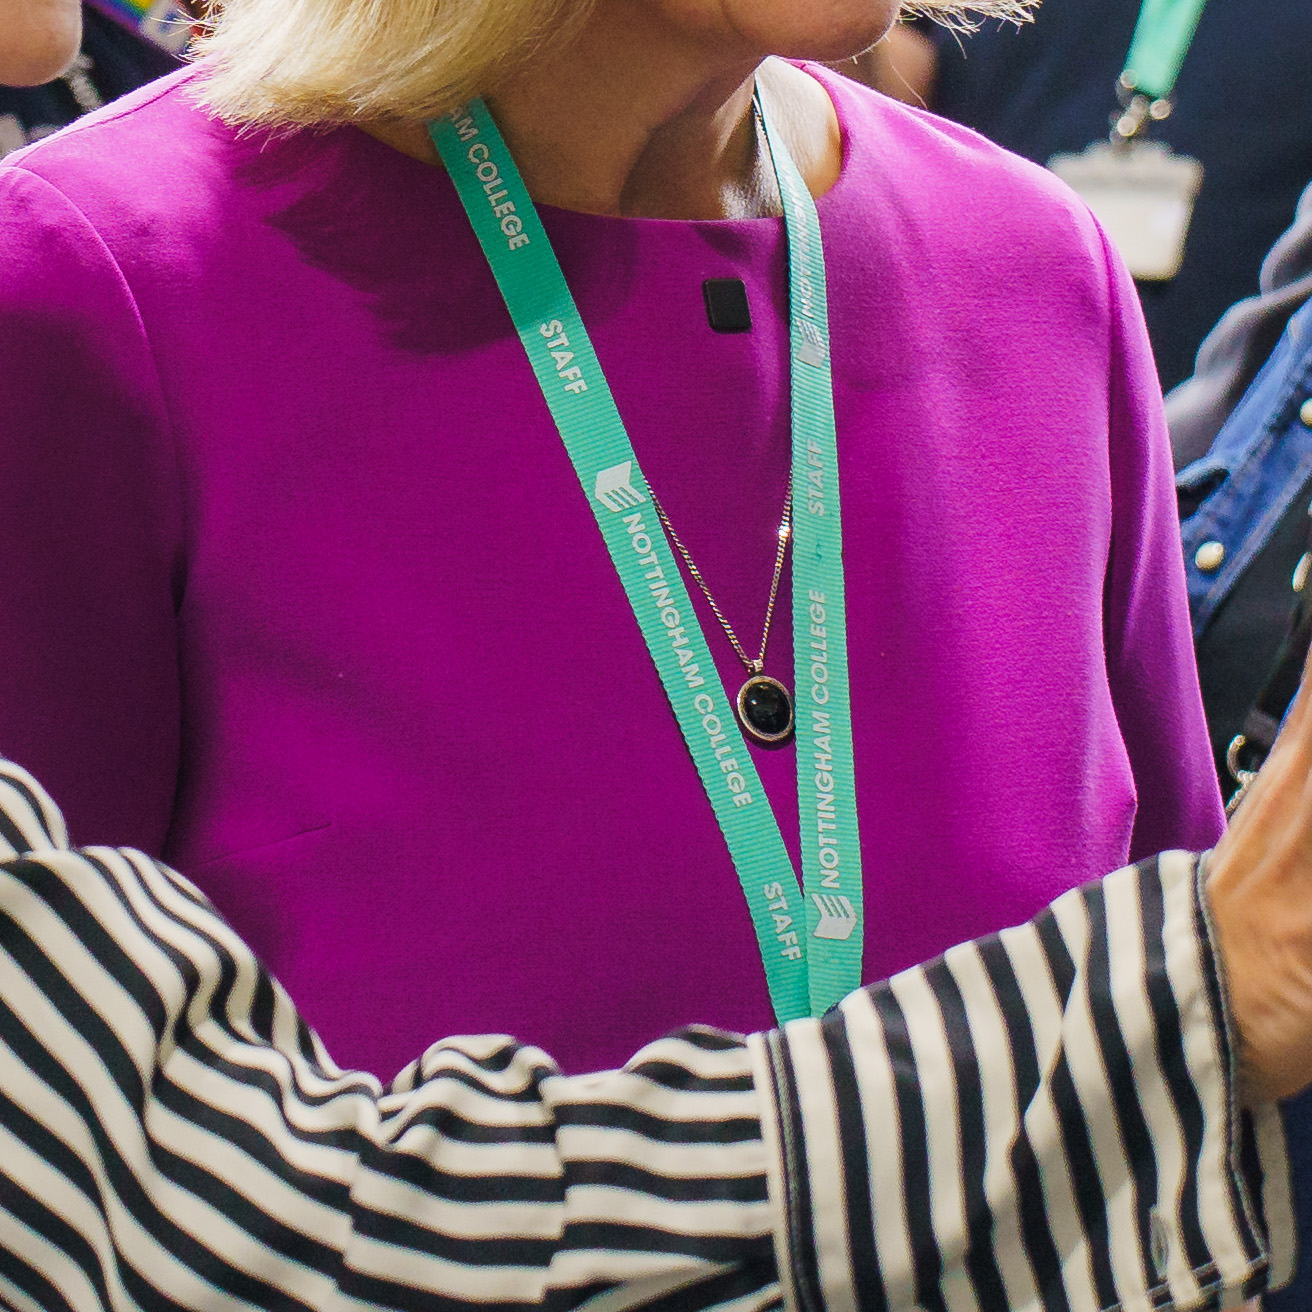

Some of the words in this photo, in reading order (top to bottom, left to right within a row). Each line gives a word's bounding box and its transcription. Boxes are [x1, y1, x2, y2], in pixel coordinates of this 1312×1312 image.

[468, 143, 530, 250] COLLEGE
[538, 319, 588, 395] STAFF
[807, 437, 824, 516] STAFF
[623, 514, 704, 689] NOTTINGHAM
[694, 693, 753, 808] COLLEGE
[807, 589, 830, 707] COLLEGE
[814, 711, 840, 888] NOTTINGHAM
[763, 881, 802, 961] STAFF
